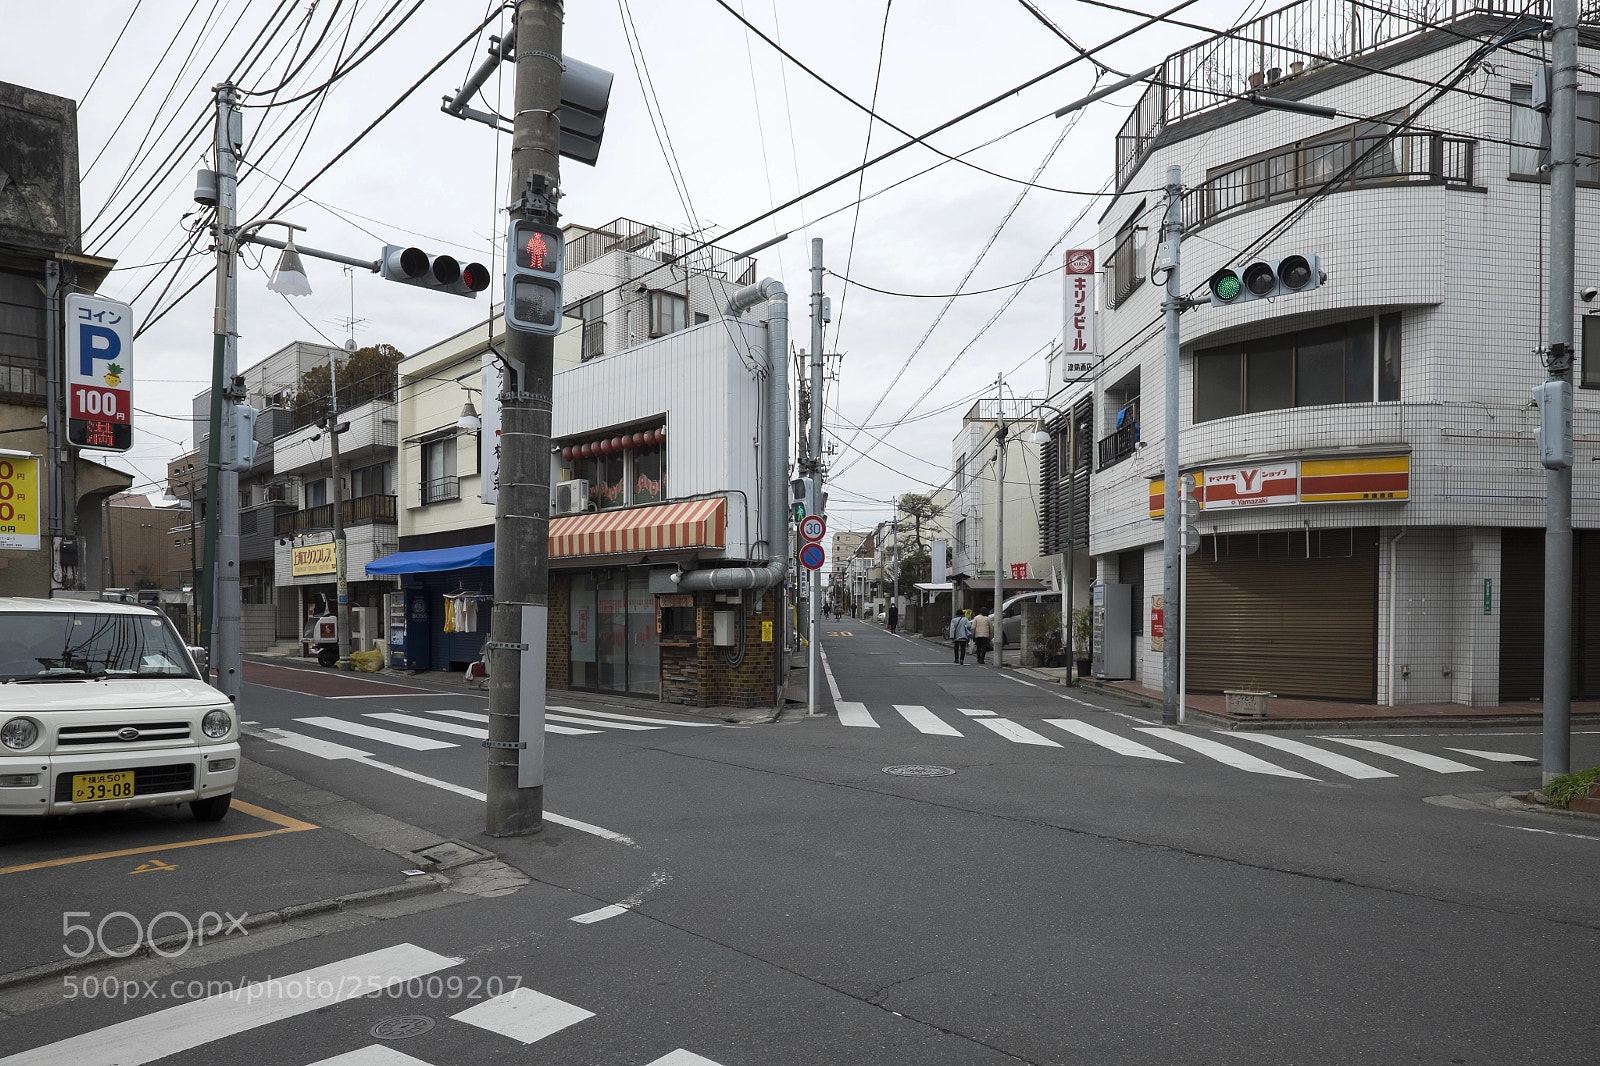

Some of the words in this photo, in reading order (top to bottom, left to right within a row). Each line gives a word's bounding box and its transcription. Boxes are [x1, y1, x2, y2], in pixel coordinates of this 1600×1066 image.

[78, 307, 122, 324] コイン
[1074, 277, 1087, 351] キリンビール
[80, 323, 122, 376] P
[1208, 474, 1237, 483] ヤマザキ
[1239, 469, 1259, 491] Y
[1261, 469, 1288, 478] ショップ
[1237, 498, 1268, 506] Yamazaki
[806, 522, 821, 535] 30
[86, 782, 131, 799] 39-08
